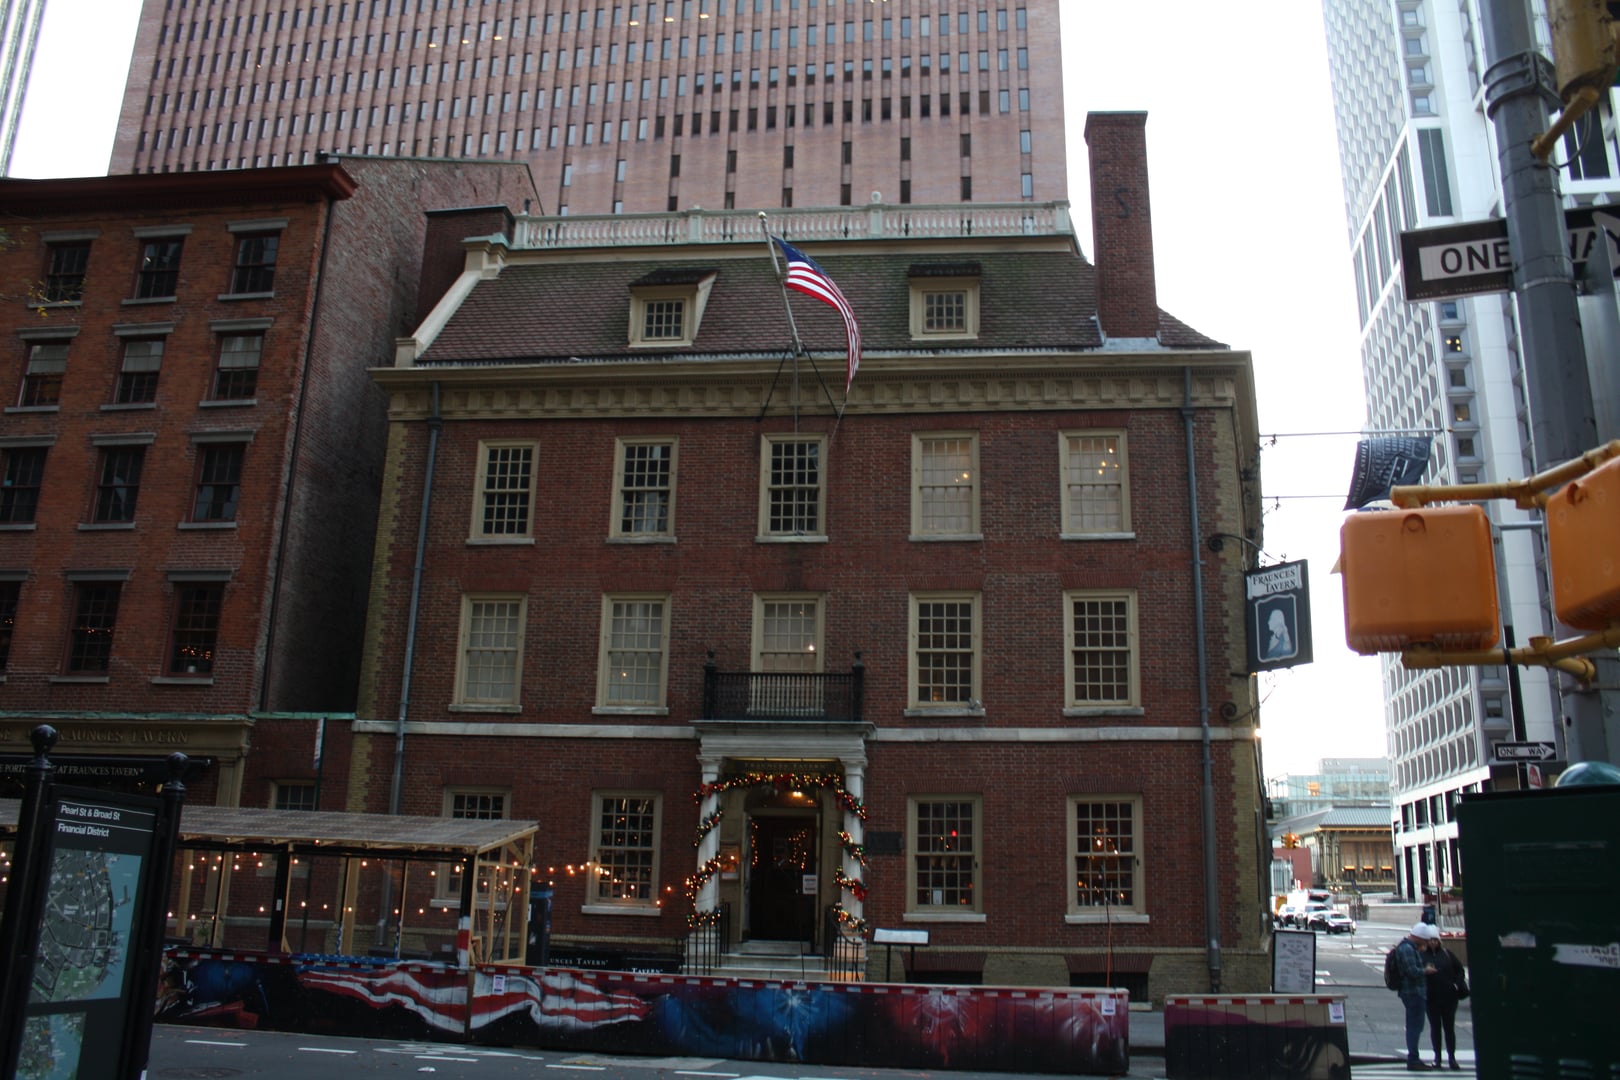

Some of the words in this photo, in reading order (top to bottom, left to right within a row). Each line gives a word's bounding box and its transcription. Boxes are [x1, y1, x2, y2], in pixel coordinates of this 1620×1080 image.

[1440, 240, 1511, 275] ONE
[1252, 568, 1297, 585] FRAUNCES
[1265, 578, 1297, 593] TAVERN
[1527, 746, 1547, 756] WAY
[69, 765, 111, 776] FRAUNCES
[60, 804, 79, 816] Pearl
[79, 807, 87, 817] St
[87, 809, 93, 817] &
[93, 809, 112, 820] Broad
[113, 811, 120, 821] St
[57, 822, 86, 835] Financial
[86, 826, 110, 837] District
